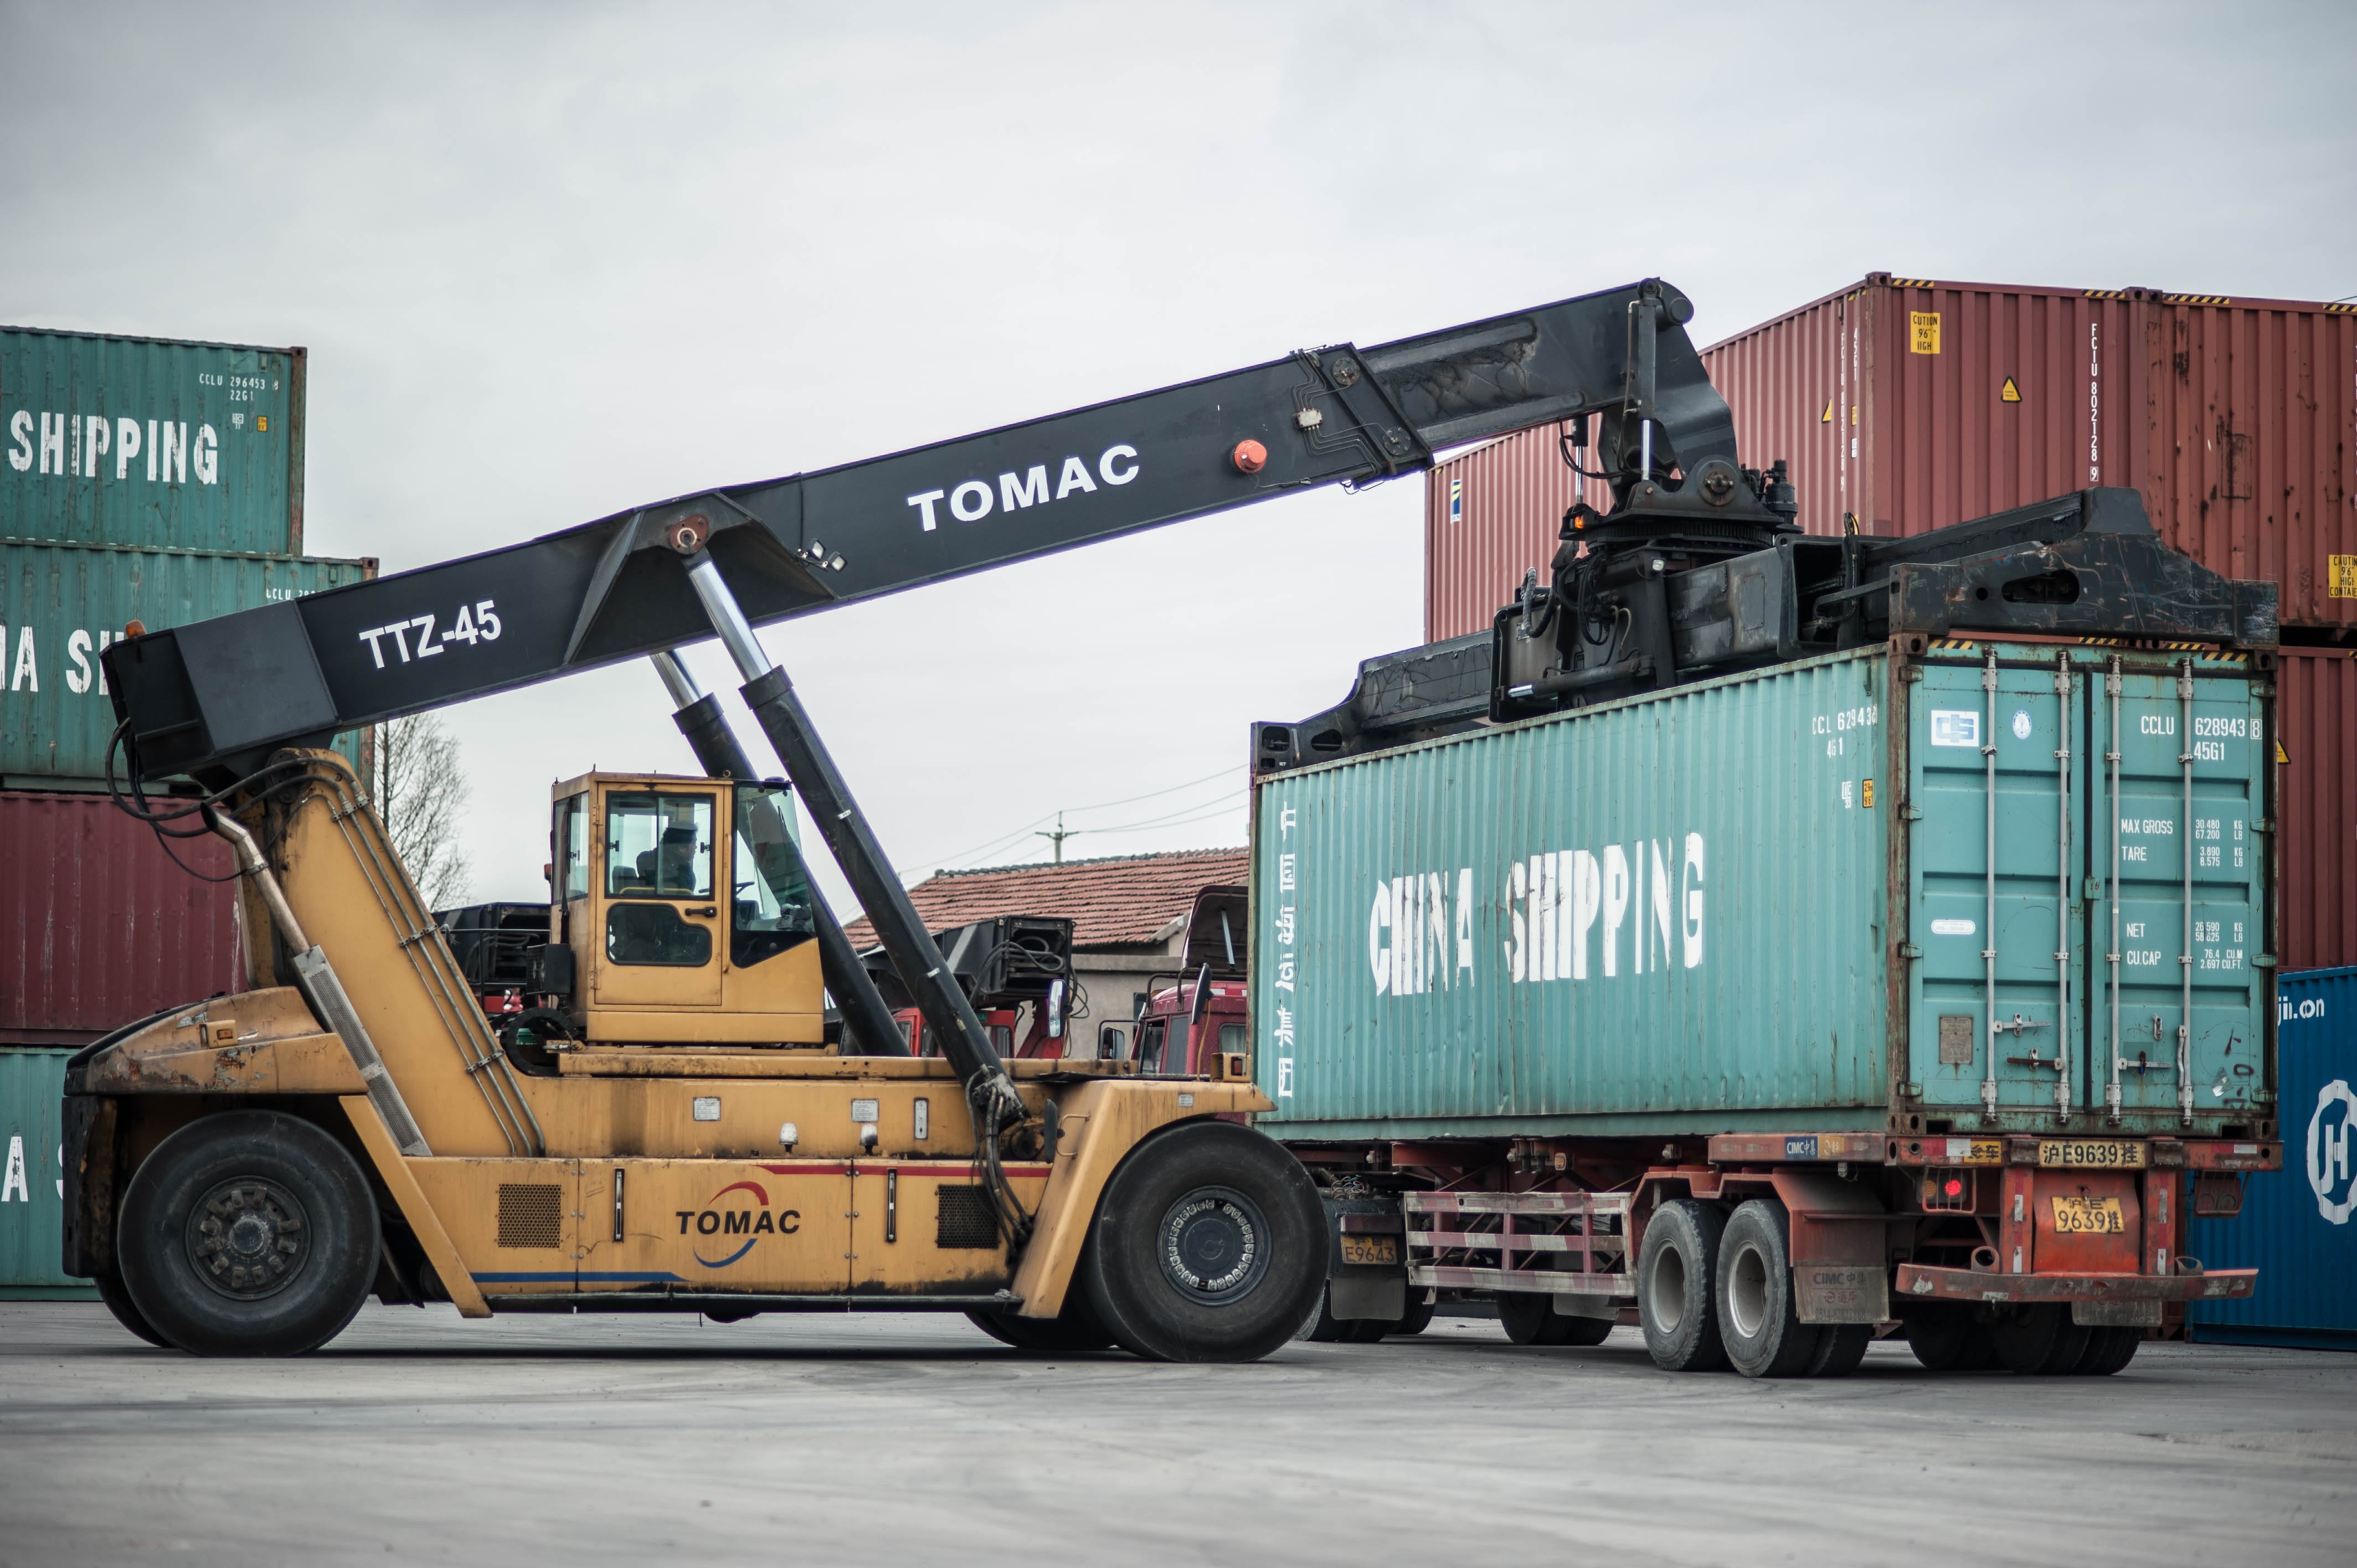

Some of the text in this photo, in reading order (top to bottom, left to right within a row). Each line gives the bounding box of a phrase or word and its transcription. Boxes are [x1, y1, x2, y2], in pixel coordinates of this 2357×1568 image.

[199, 373, 223, 386] CCLU
[230, 376, 265, 389] 296453
[230, 390, 253, 401] 22G1
[8, 410, 218, 484] SHIPPING
[2091, 467, 2098, 481] 9
[908, 445, 1139, 532] TOMAC
[359, 600, 501, 668] TTZ-45
[2141, 715, 2261, 739] CCLU 628943 8
[2194, 741, 2224, 760] 45G1
[2121, 819, 2242, 834] MAX GROSS 30.480 KG
[2195, 829, 2242, 840] 67.200 LB
[2122, 846, 2243, 861] TARE 3.890 KG
[2200, 857, 2243, 867] 8.575 LB
[1370, 832, 1704, 997] CHINA SHIPPING
[2127, 922, 2243, 937] NET 26590 KG
[2234, 932, 2243, 942] LB
[2127, 949, 2243, 965] CU.CAP 76.4 CU.M
[2200, 960, 2220, 969] 2.697
[2044, 1143, 2138, 1164] 沪E9639挂
[676, 1210, 801, 1235] TOMAC
[2058, 1210, 2121, 1230] 9639挂
[1345, 1246, 1394, 1262] E9643
